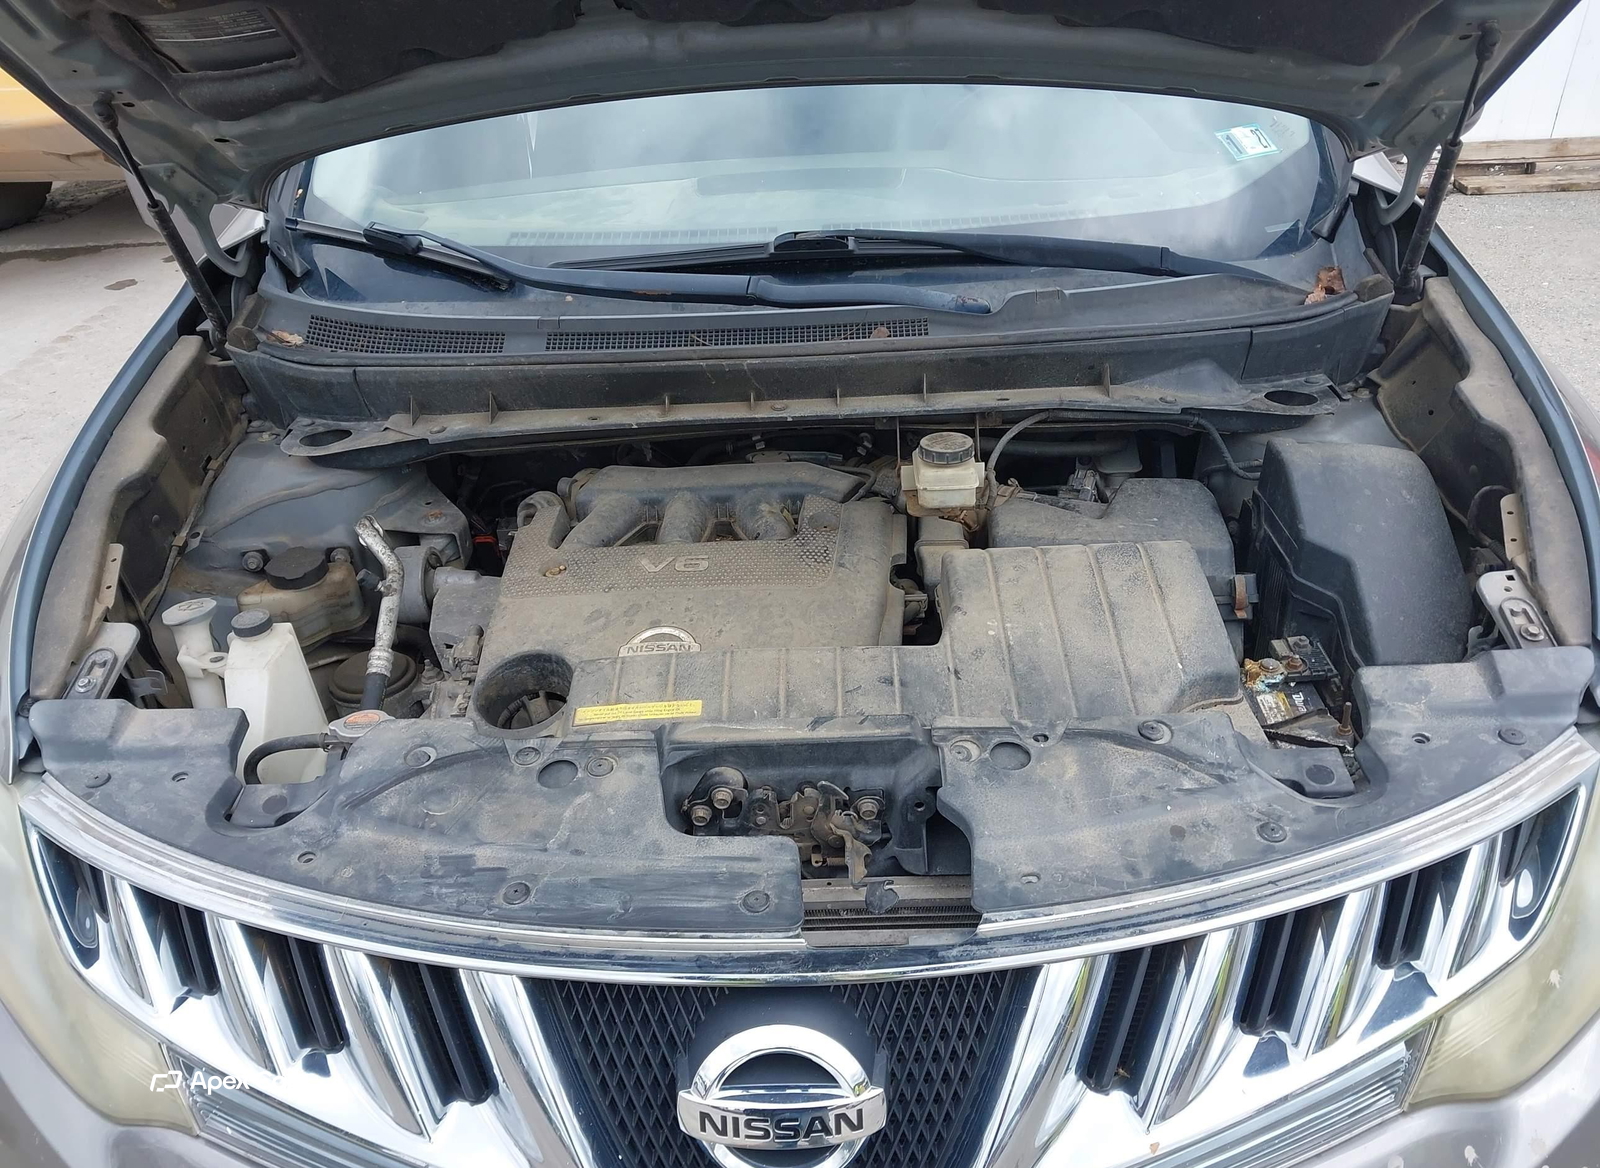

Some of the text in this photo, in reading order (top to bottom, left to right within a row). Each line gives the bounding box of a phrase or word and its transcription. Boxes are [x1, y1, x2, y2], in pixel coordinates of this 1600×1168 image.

[638, 555, 710, 573] V6
[626, 643, 692, 655] NISSAN
[1291, 691, 1307, 713] Dura
[699, 1108, 864, 1142] NISSAN
